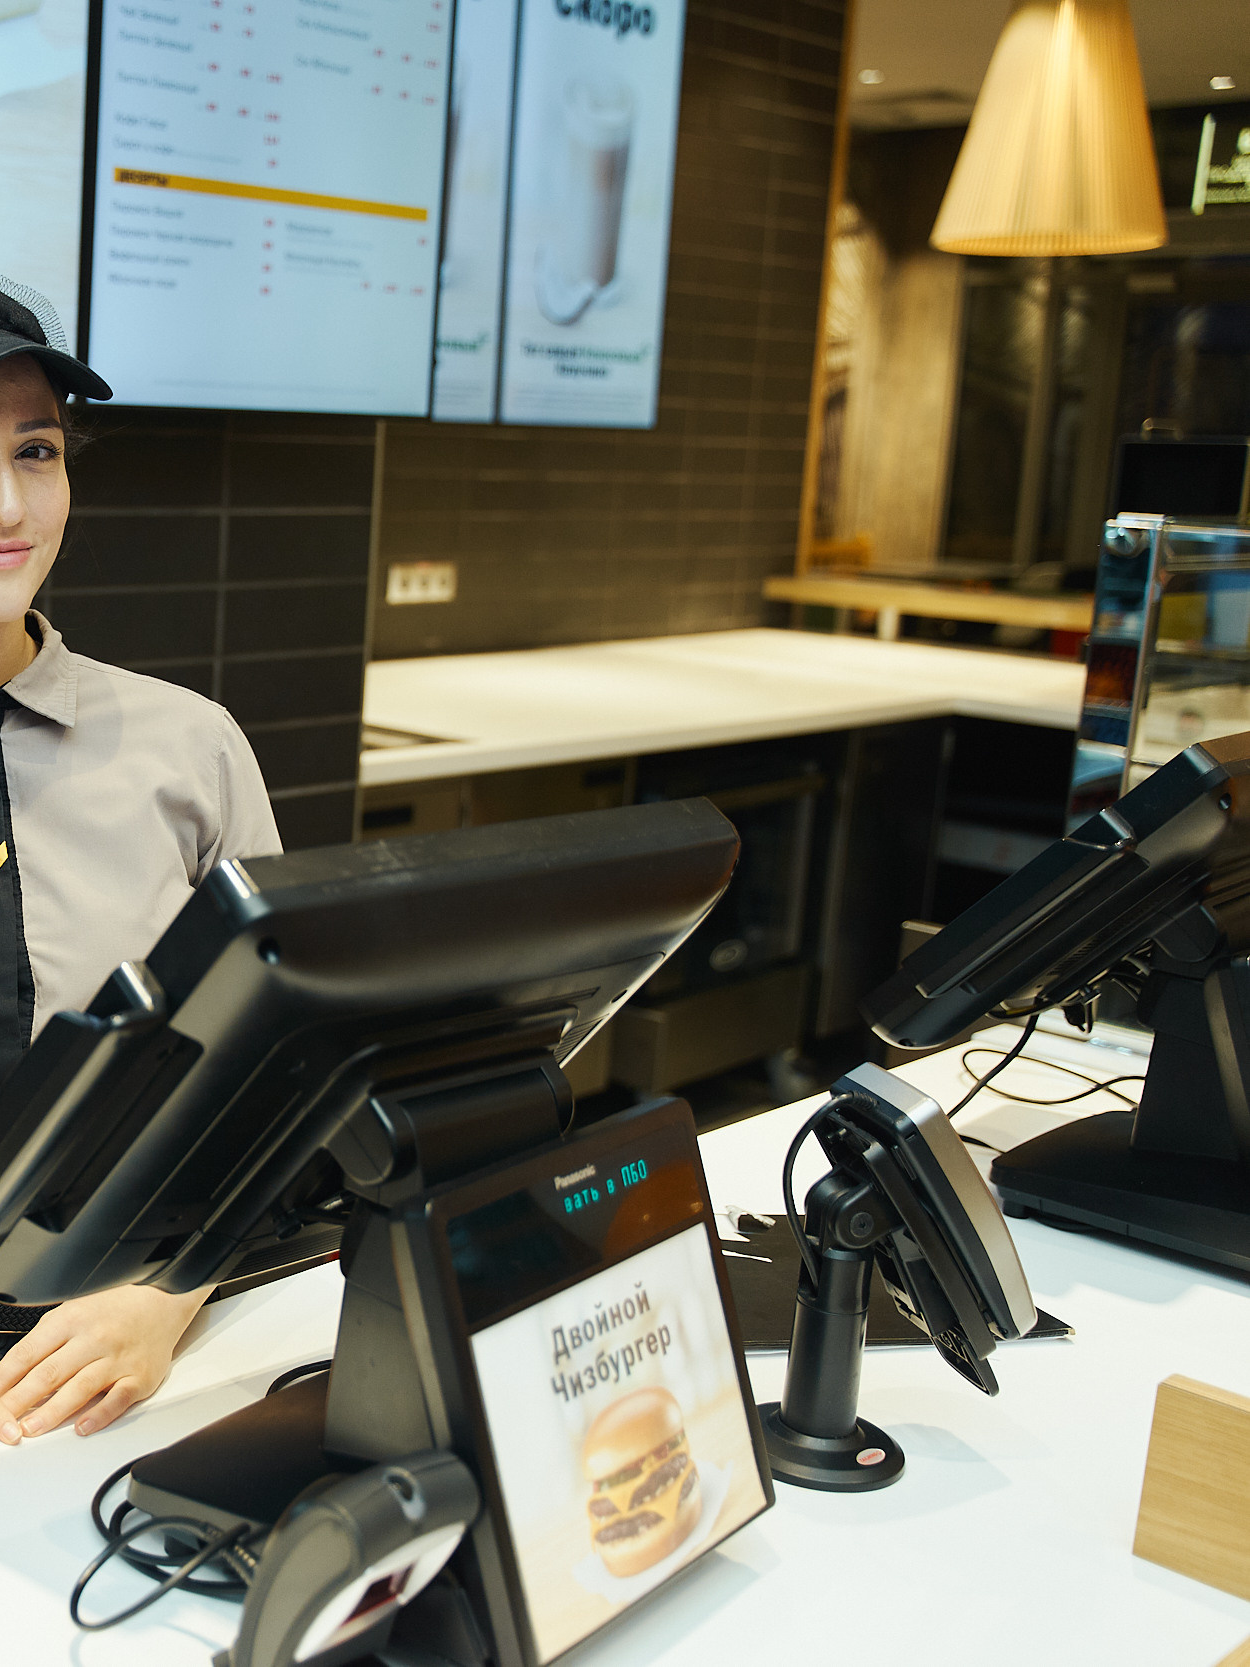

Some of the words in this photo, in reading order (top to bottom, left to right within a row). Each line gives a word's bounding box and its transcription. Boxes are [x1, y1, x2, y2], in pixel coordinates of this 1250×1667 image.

[554, 1163, 597, 1191] Panasonic
[551, 1281, 652, 1366] Двойной
[551, 1324, 672, 1402] Чизбургер
